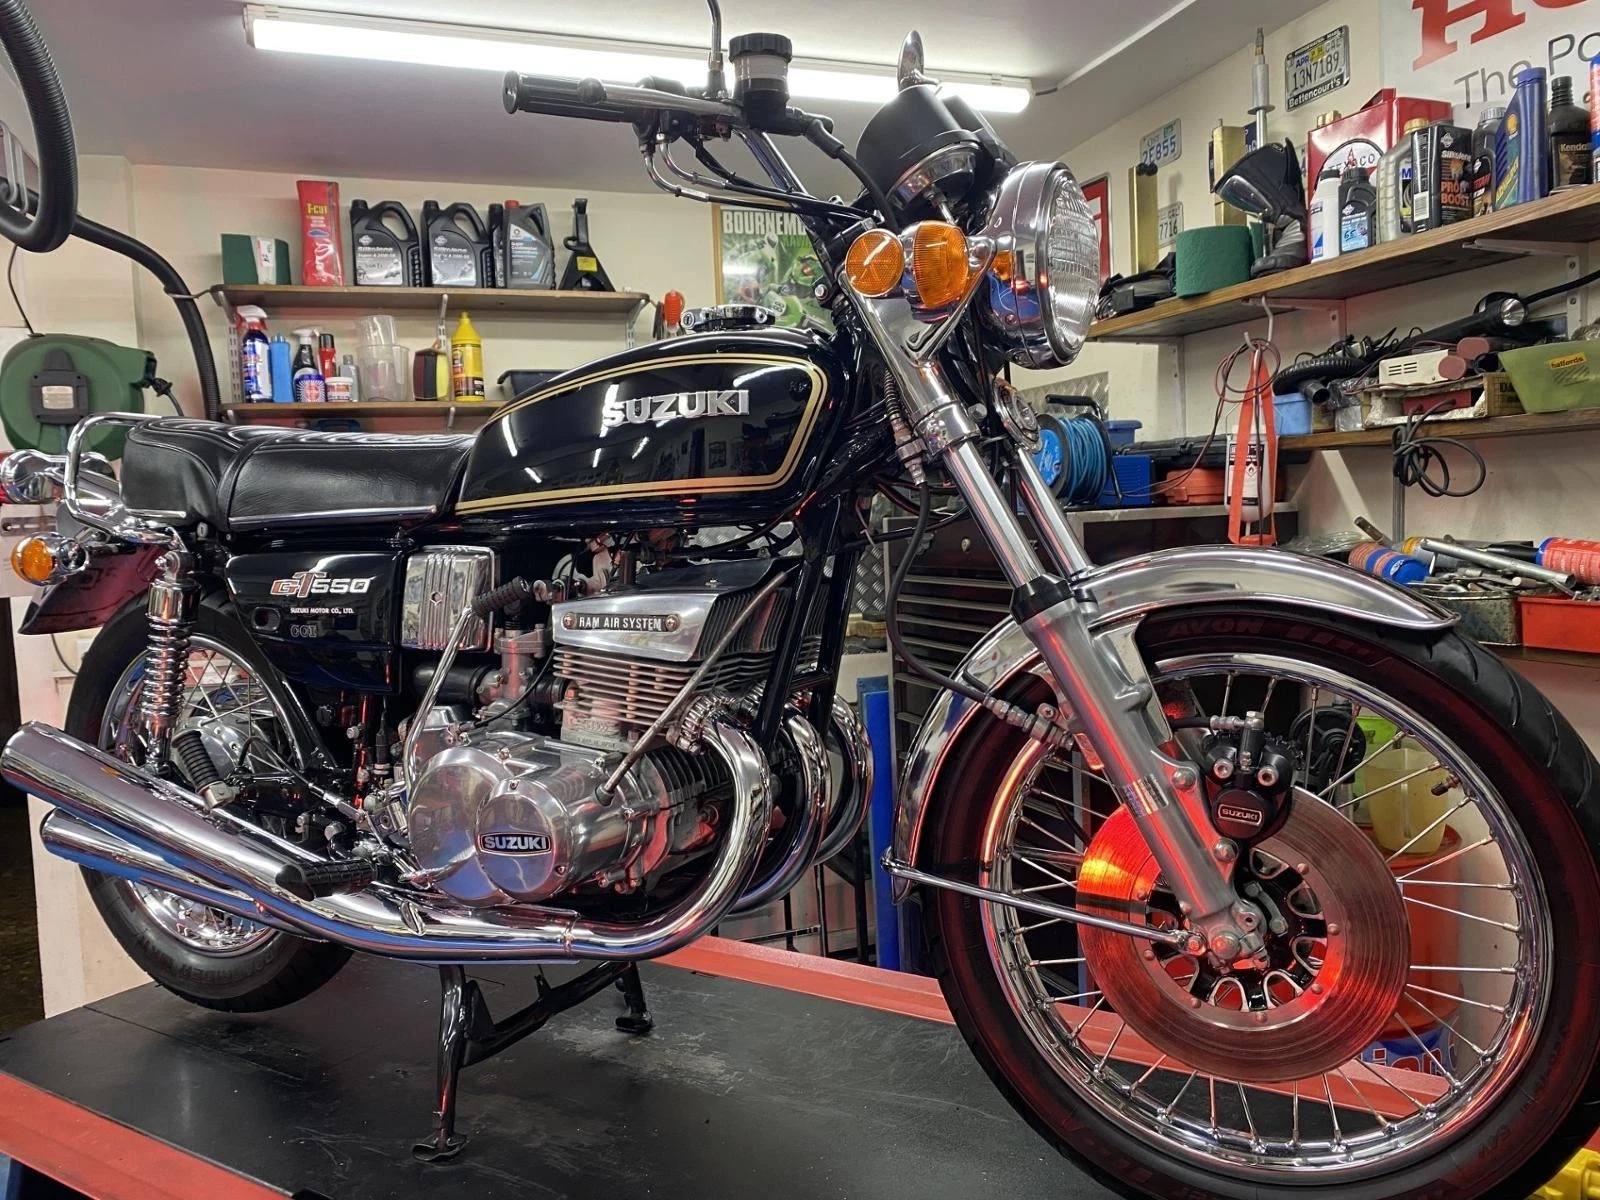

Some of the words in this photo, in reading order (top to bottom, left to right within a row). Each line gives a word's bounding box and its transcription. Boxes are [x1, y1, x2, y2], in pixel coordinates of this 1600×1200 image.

[1292, 51, 1340, 92] 13N7189
[1454, 60, 1531, 109] The
[1288, 77, 1341, 108] Bettencourt's
[1560, 143, 1592, 152] Kenda
[1440, 181, 1460, 193] PRO
[1440, 192, 1470, 206] BOOST
[602, 390, 749, 427] SUZUKI
[270, 571, 372, 599] GT550
[579, 616, 600, 628] RAM
[603, 616, 620, 629] AIR
[622, 617, 662, 631] SYSTEM
[1222, 807, 1259, 821] SUZUKI
[484, 836, 547, 850] SUZUKI
